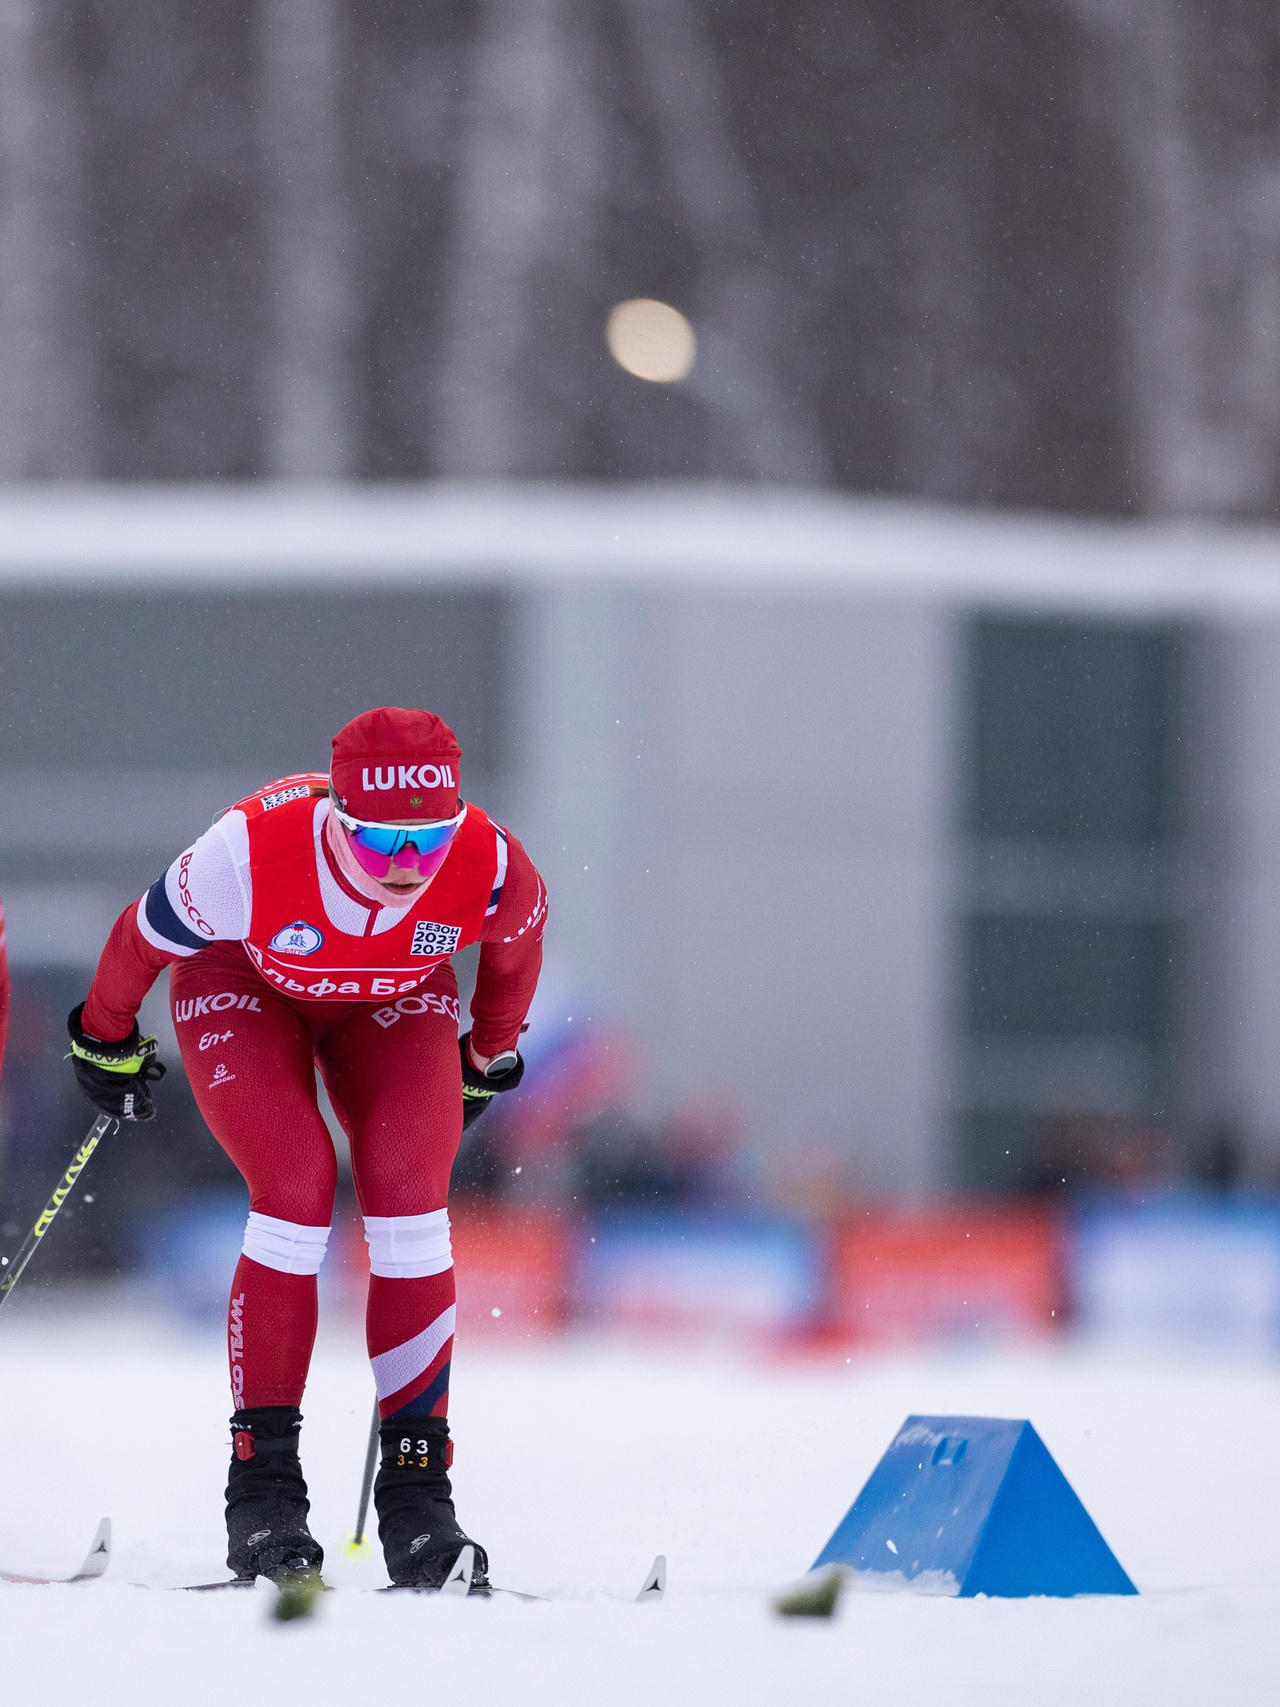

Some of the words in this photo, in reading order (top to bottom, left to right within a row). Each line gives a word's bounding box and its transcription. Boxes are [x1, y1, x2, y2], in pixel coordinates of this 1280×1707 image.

[362, 764, 455, 791] LUKOIL
[178, 852, 216, 936] BOSCO
[414, 931, 457, 945] 2023
[416, 921, 460, 935] СЕЗОН
[411, 944, 455, 955] 2024
[247, 943, 360, 997] Альфа
[175, 992, 262, 1023] LUKOIL
[229, 1292, 246, 1362] TEAM
